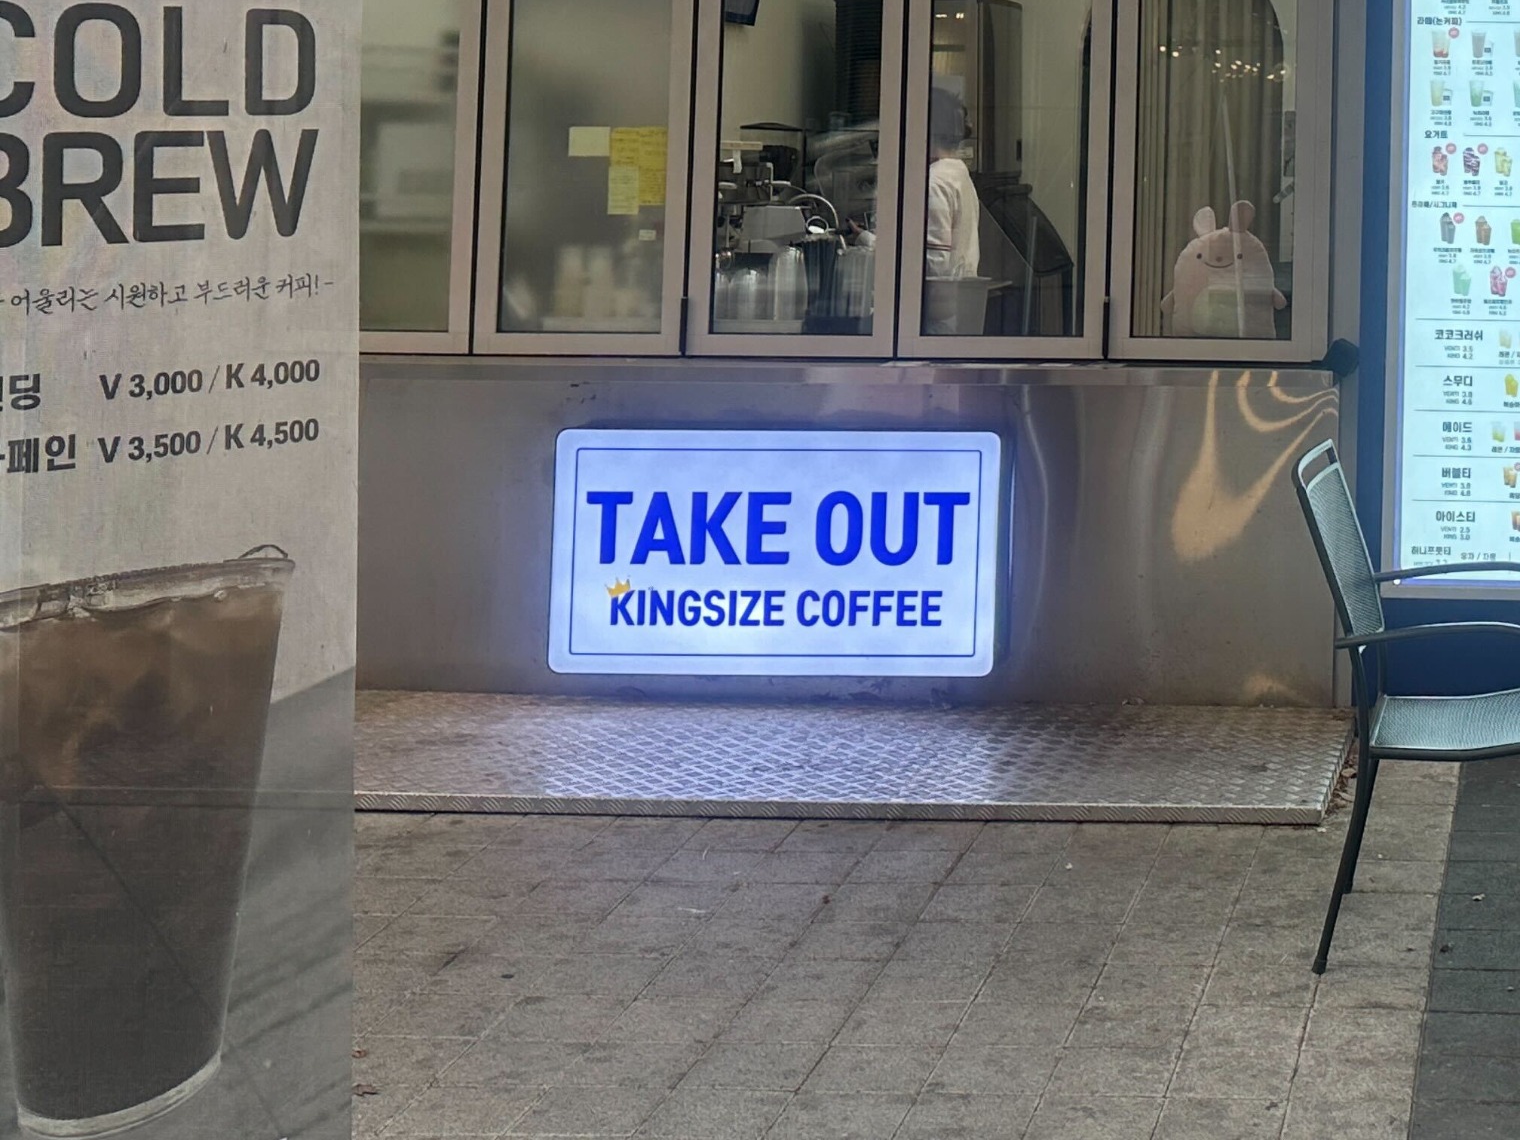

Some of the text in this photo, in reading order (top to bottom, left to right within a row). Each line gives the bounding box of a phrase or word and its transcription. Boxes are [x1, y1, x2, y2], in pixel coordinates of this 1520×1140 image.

[10, 285, 98, 315] 어울리는
[104, 282, 188, 310] 시원하고
[194, 276, 271, 304] 부드러운
[1434, 329, 1483, 341] 코코크러쉬
[0, 373, 41, 411] 딩
[99, 373, 122, 400] V
[128, 369, 203, 400] 3,000
[225, 363, 245, 390] K
[250, 359, 320, 388] 4,000
[1443, 376, 1473, 387] 스무디
[0, 434, 76, 474] 페인
[97, 436, 121, 463] V
[128, 430, 201, 462] 3,500
[224, 423, 244, 450] K
[249, 418, 319, 449] 4,500
[1442, 468, 1471, 479] 버블티
[586, 491, 970, 566] TAKE OUT
[1435, 510, 1475, 522] 아이스티
[610, 589, 943, 627] KINGSIZE COFFEE
